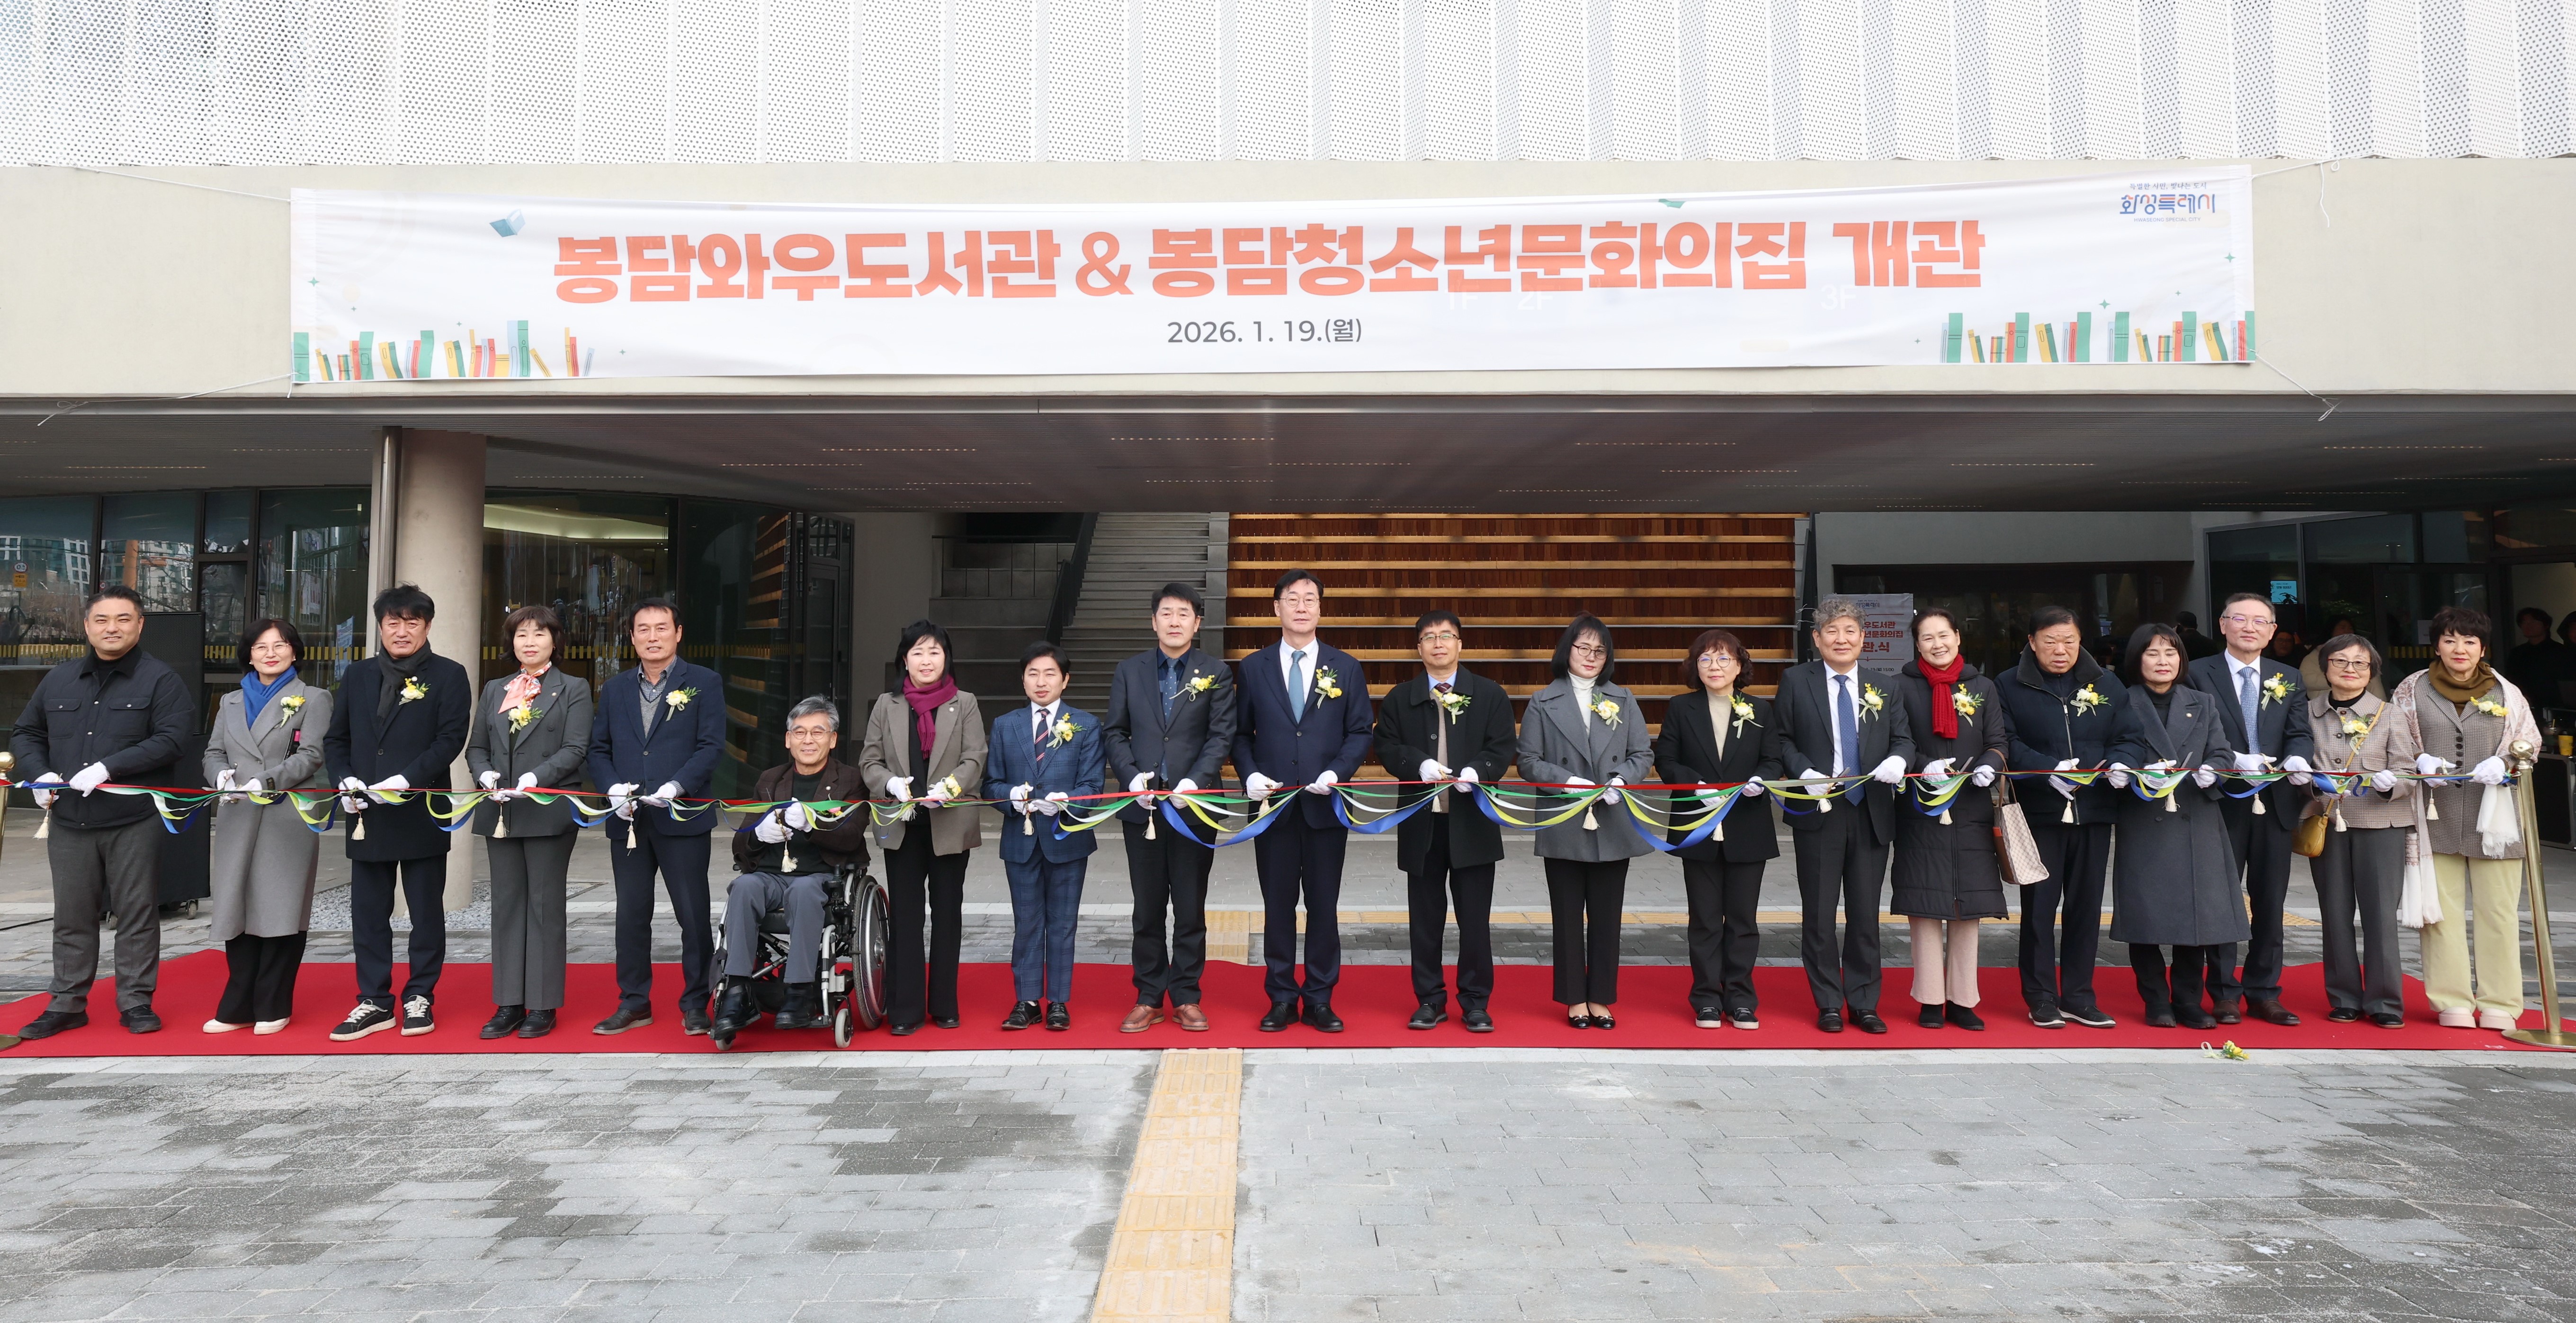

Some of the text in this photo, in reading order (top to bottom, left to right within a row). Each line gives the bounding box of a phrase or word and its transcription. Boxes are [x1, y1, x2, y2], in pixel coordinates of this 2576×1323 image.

[2171, 182, 2191, 190] 빛나는
[2120, 194, 2216, 215] 화성특례시
[554, 220, 1986, 304] 봉담와우도서관 & 봉담청소년문화의집 개관
[1167, 317, 1362, 343] 2026. 1. 19.(월)
[1861, 642, 1889, 652] 관.식
